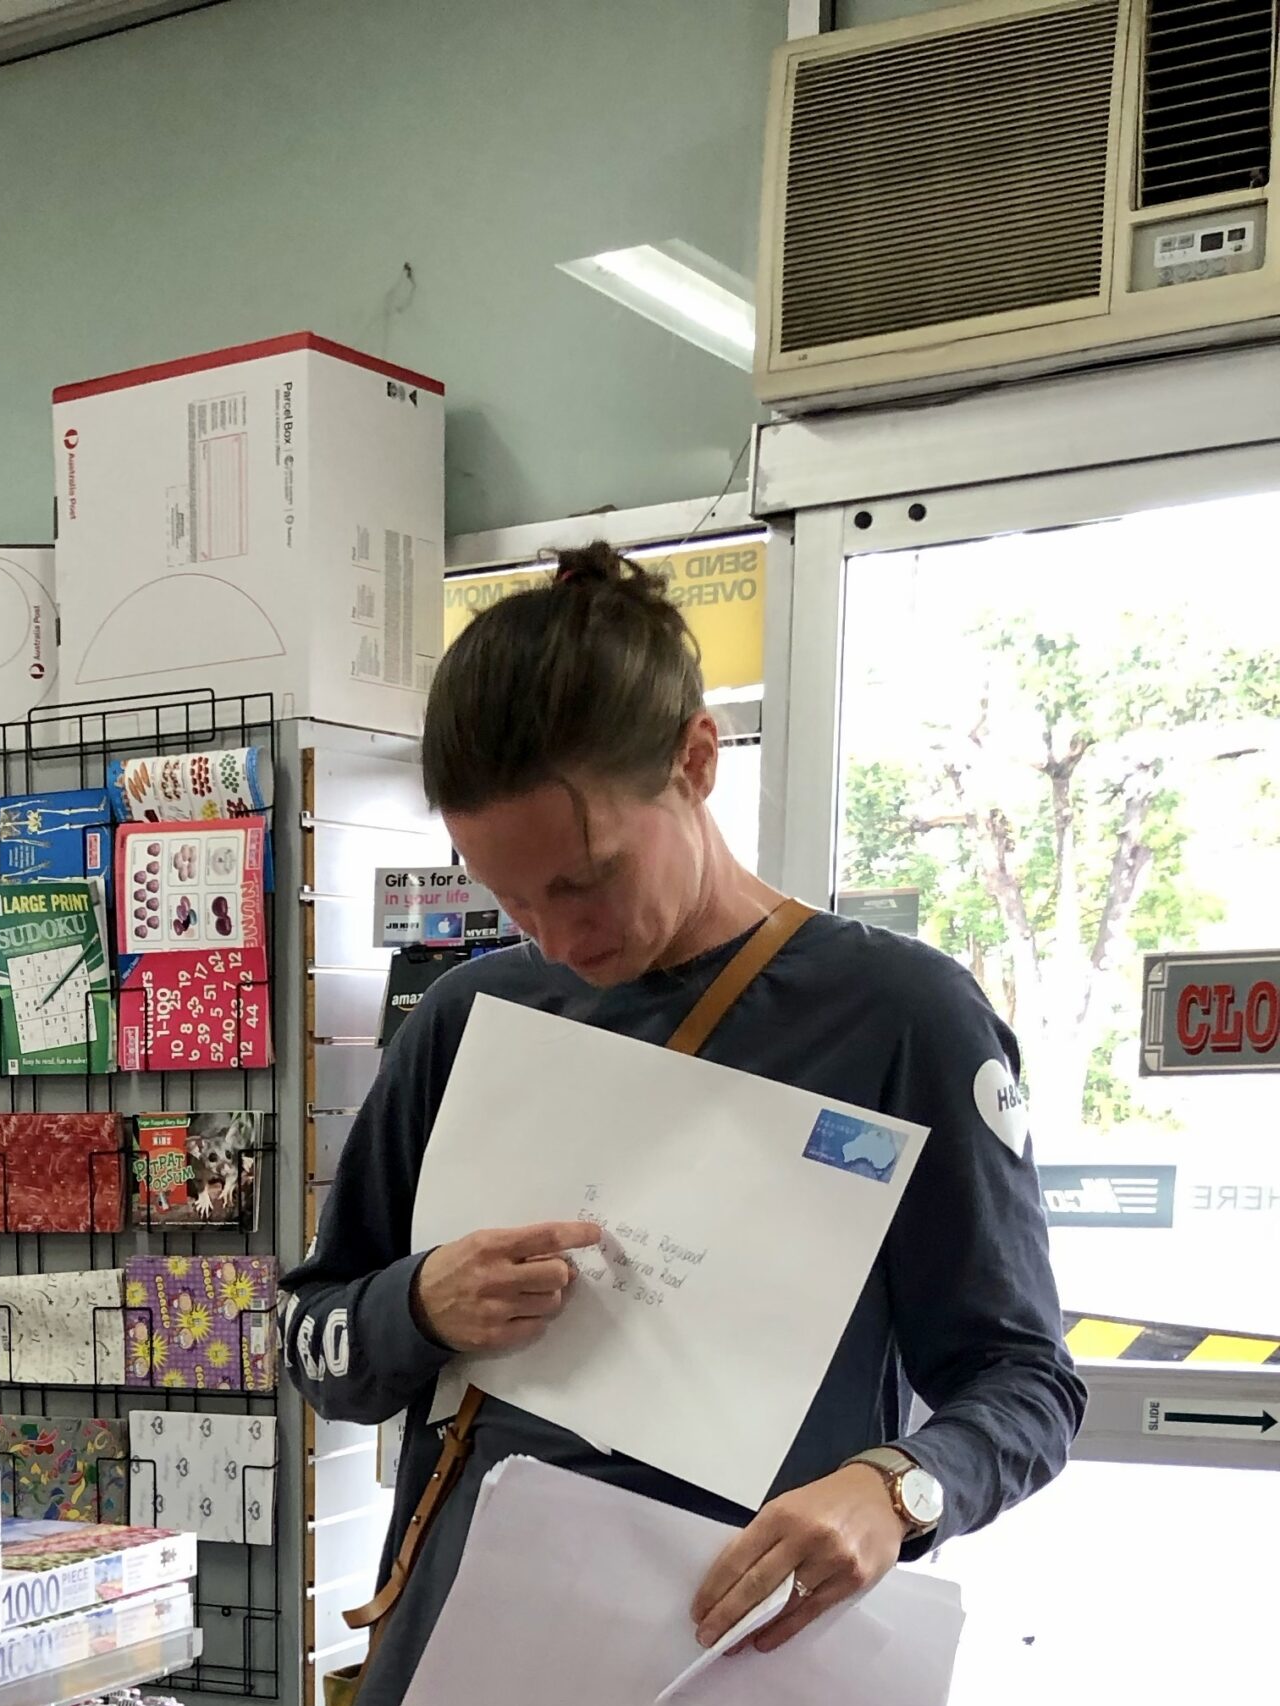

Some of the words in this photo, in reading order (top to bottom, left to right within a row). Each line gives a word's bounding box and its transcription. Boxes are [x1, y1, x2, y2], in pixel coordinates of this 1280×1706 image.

[283, 381, 293, 420] Parcel
[284, 422, 294, 444] Box
[68, 453, 77, 496] Australia
[69, 498, 77, 520] Post
[34, 605, 42, 624] Post
[33, 625, 42, 660] Australia
[385, 873, 426, 887] Gifs
[430, 872, 453, 886] for
[3, 894, 47, 914] LARGE
[50, 894, 89, 912] PRINT
[384, 893, 399, 905] in
[446, 889, 470, 904] life
[465, 927, 497, 937] MYER
[208, 951, 226, 973] 42
[228, 951, 242, 969] 12
[178, 970, 192, 988] 19
[194, 962, 209, 980] 17
[204, 984, 217, 1000] 51
[223, 981, 237, 991] 7
[170, 990, 181, 1010] 25
[187, 996, 204, 1018] 33
[391, 993, 424, 1006] amaz
[139, 971, 154, 1055] Numbers
[156, 987, 170, 1037] 1-100
[210, 1007, 223, 1018] 5
[246, 1003, 259, 1029] 44
[1177, 979, 1280, 1055] CLO
[180, 1023, 193, 1034] 8
[197, 1023, 210, 1044] 39
[222, 1019, 235, 1044] 40
[171, 1040, 184, 1059] 10
[188, 1049, 200, 1061] 6
[210, 1042, 224, 1062] 52
[240, 1040, 253, 1058] 12
[132, 1152, 185, 1182] PTPAT
[659, 1267, 688, 1289] Road
[1148, 1401, 1160, 1432] SLIDE
[2, 1573, 60, 1626] 1000
[61, 1566, 90, 1584] PIECE
